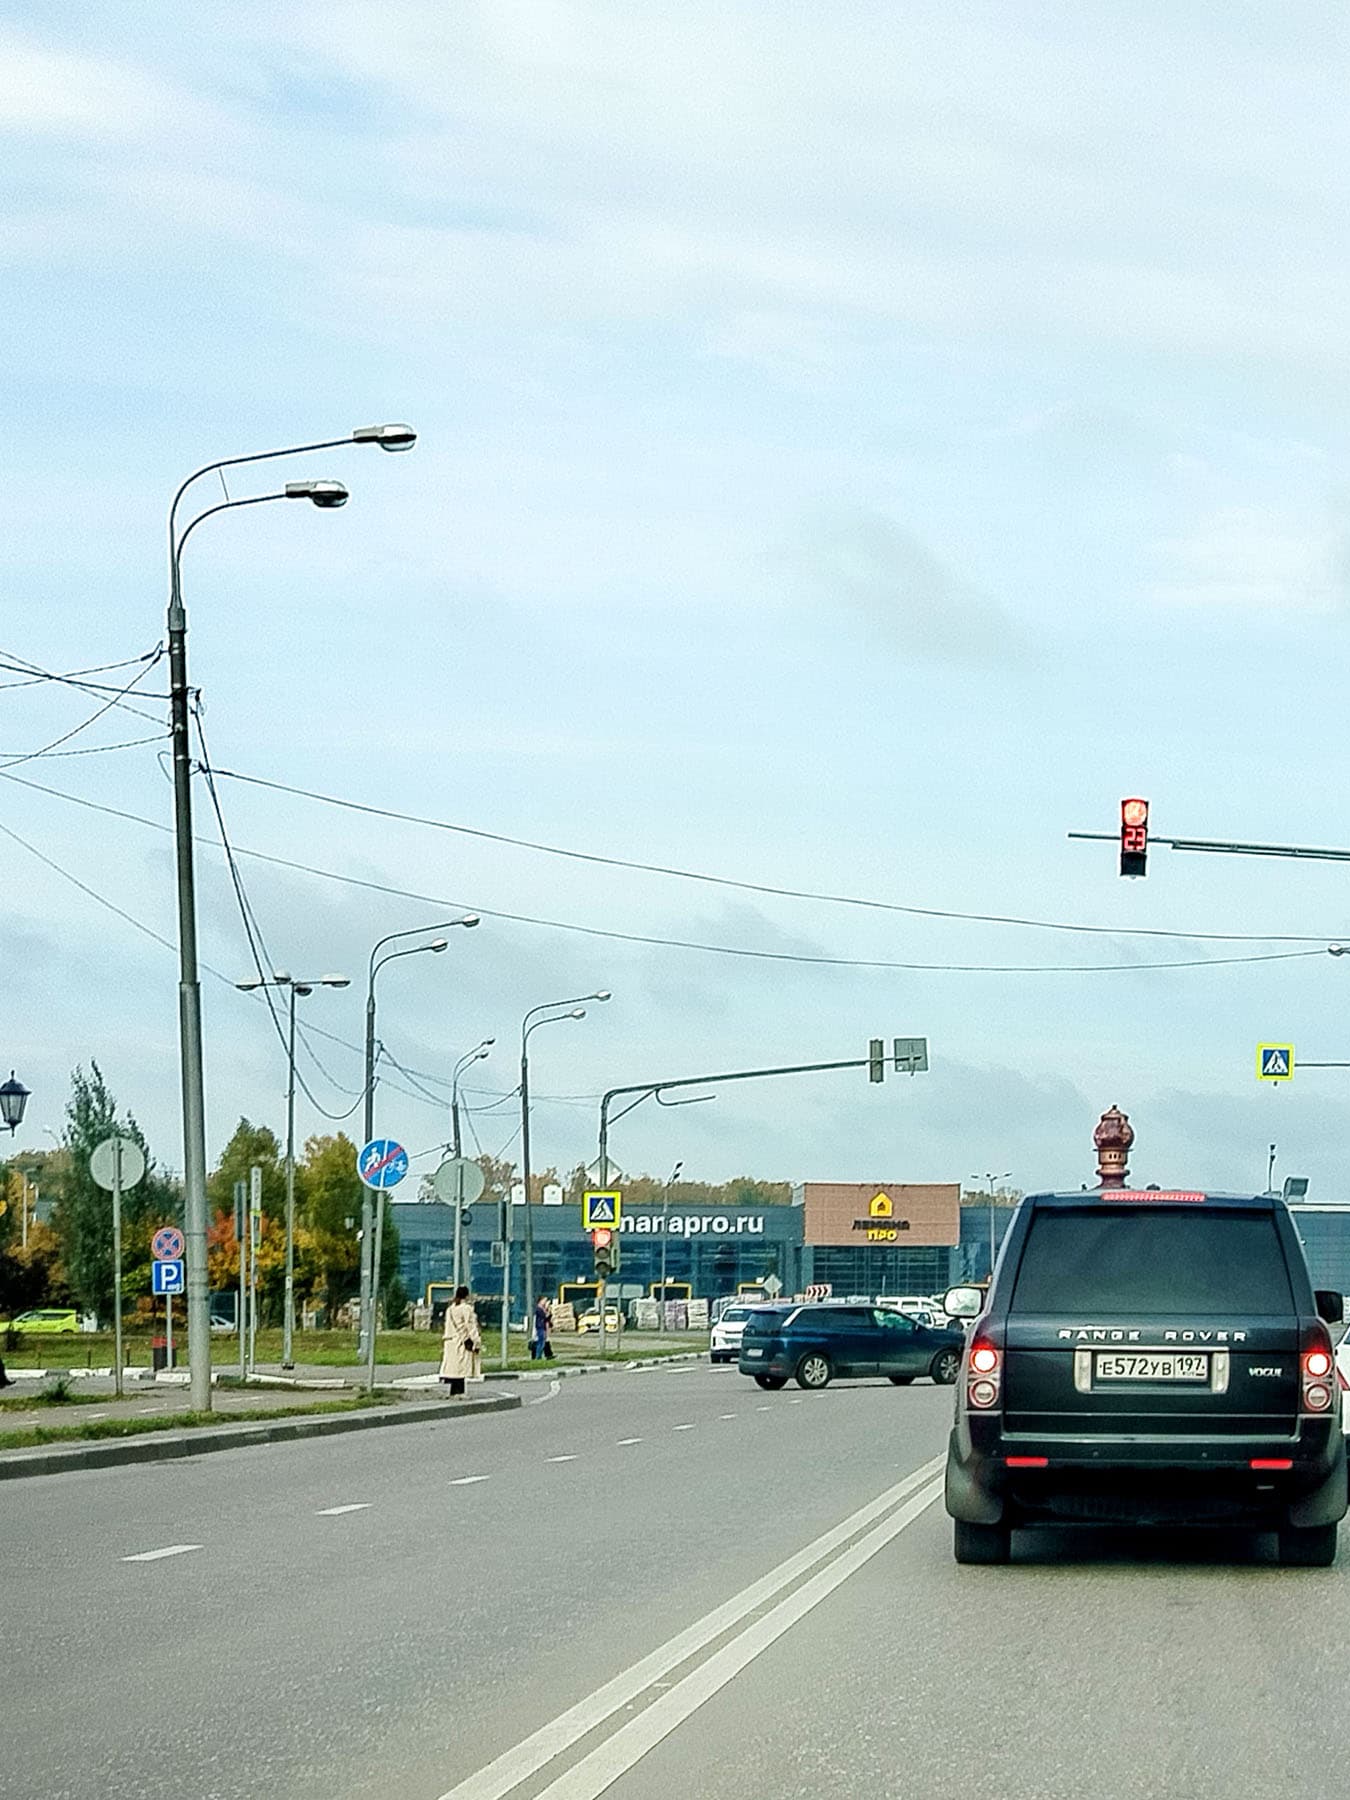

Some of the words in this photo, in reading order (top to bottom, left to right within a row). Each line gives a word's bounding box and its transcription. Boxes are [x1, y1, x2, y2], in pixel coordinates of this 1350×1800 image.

[1124, 828, 1146, 850] 23
[586, 1215, 764, 1238] manapro.ru
[161, 1264, 178, 1290] P
[1058, 1330, 1141, 1341] RANGE
[1164, 1330, 1247, 1342] ROVER
[1102, 1357, 1172, 1377] Е572УВ
[1176, 1357, 1202, 1371] 197
[1249, 1367, 1283, 1378] VOGUE
